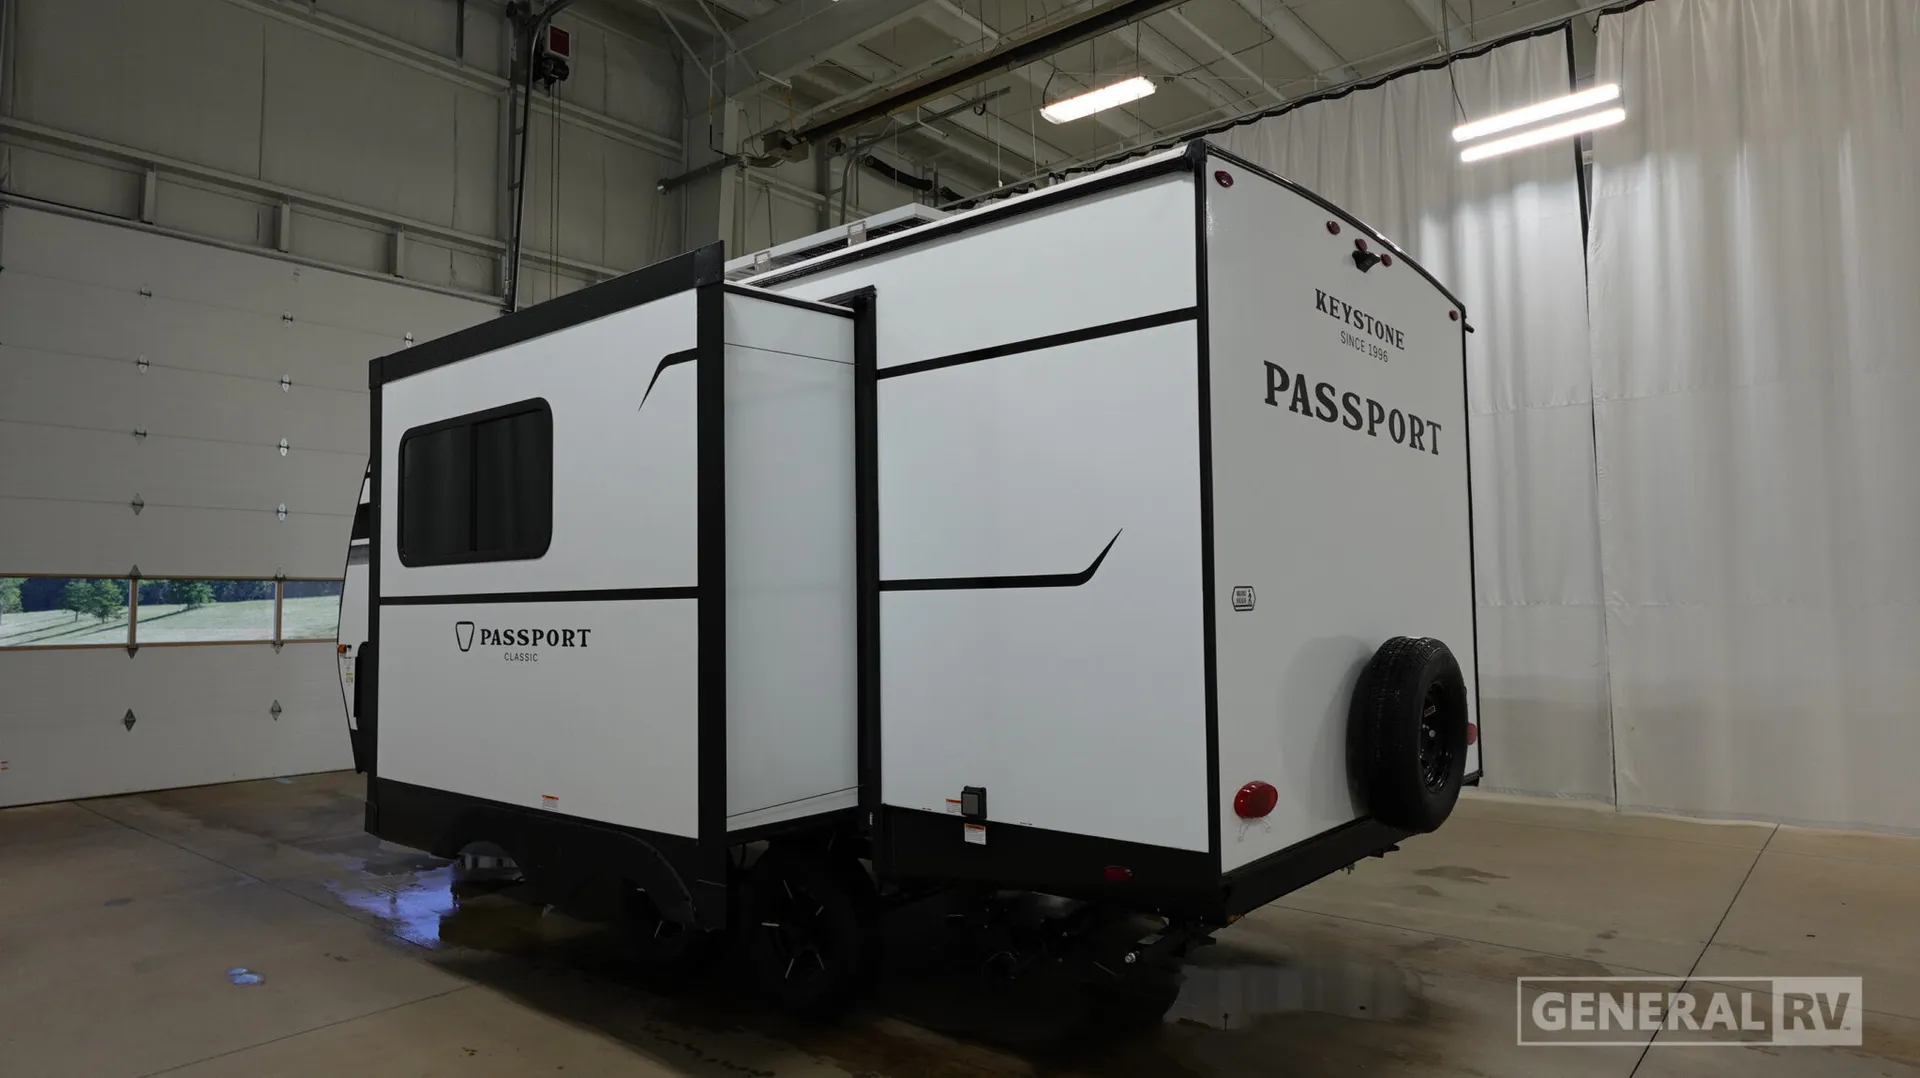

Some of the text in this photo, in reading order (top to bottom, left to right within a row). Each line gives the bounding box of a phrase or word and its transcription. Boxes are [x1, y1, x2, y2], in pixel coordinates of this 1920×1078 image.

[1315, 288, 1405, 351] KEYSTONE
[1340, 330, 1389, 363] SINCE 1996
[1263, 359, 1442, 456] PASSPORT
[480, 628, 592, 648] PASSPORT
[504, 652, 539, 662] CLASSIC
